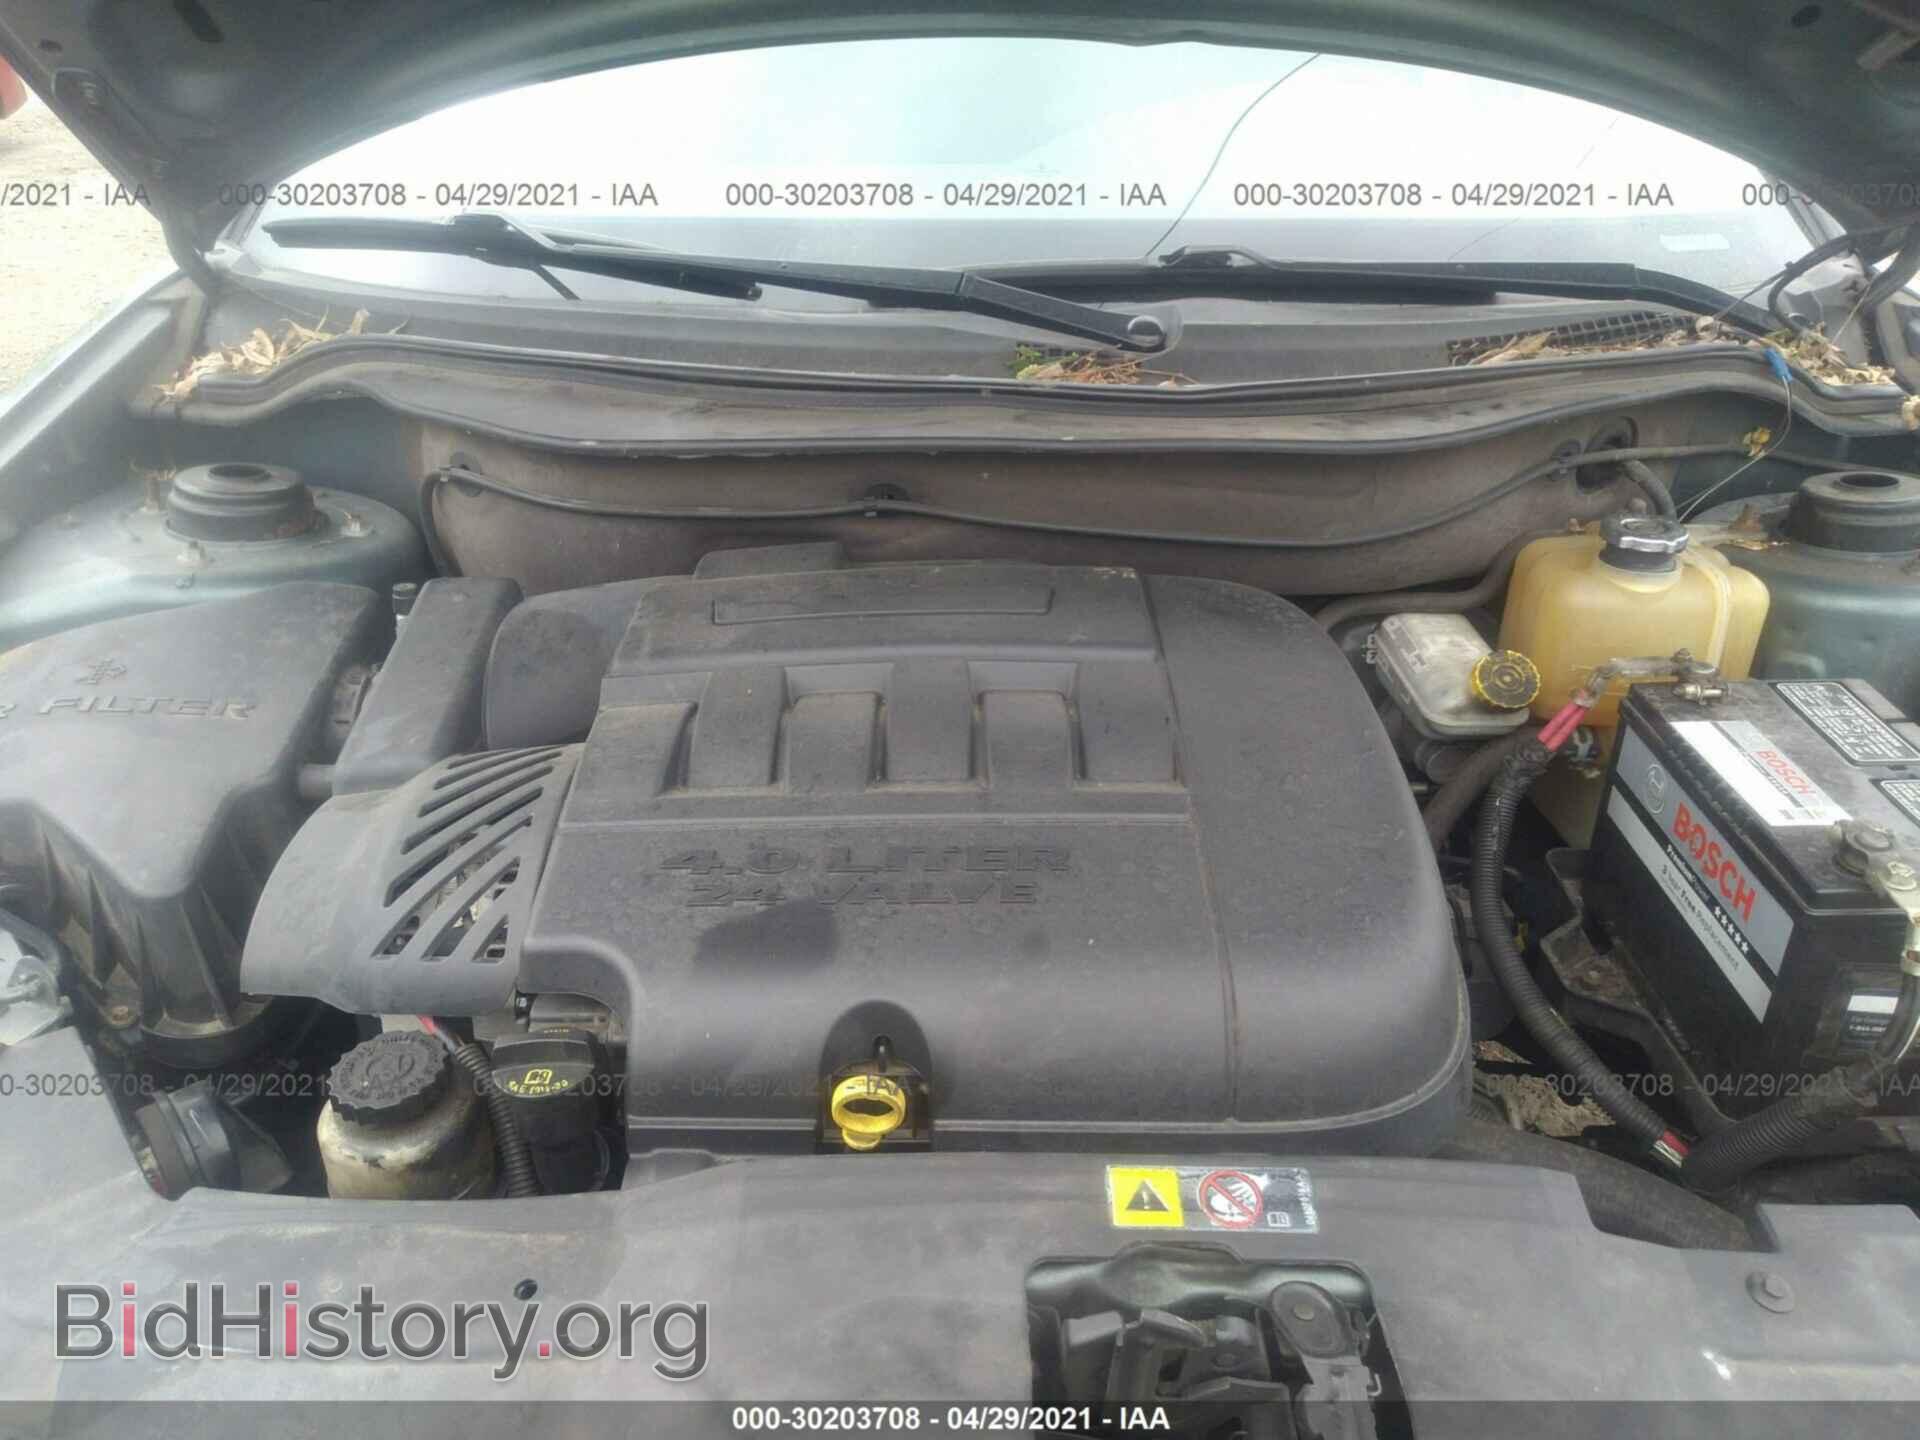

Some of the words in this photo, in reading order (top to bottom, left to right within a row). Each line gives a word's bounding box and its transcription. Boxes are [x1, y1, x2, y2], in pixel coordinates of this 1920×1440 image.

[36, 696, 256, 720] FILTER
[1749, 751, 1816, 794] BOSCH
[660, 846, 802, 876] 4.0
[826, 845, 1071, 873] LITER
[1673, 801, 1757, 925] BOSCH
[686, 882, 787, 908] 24
[816, 879, 1039, 905] VALVE
